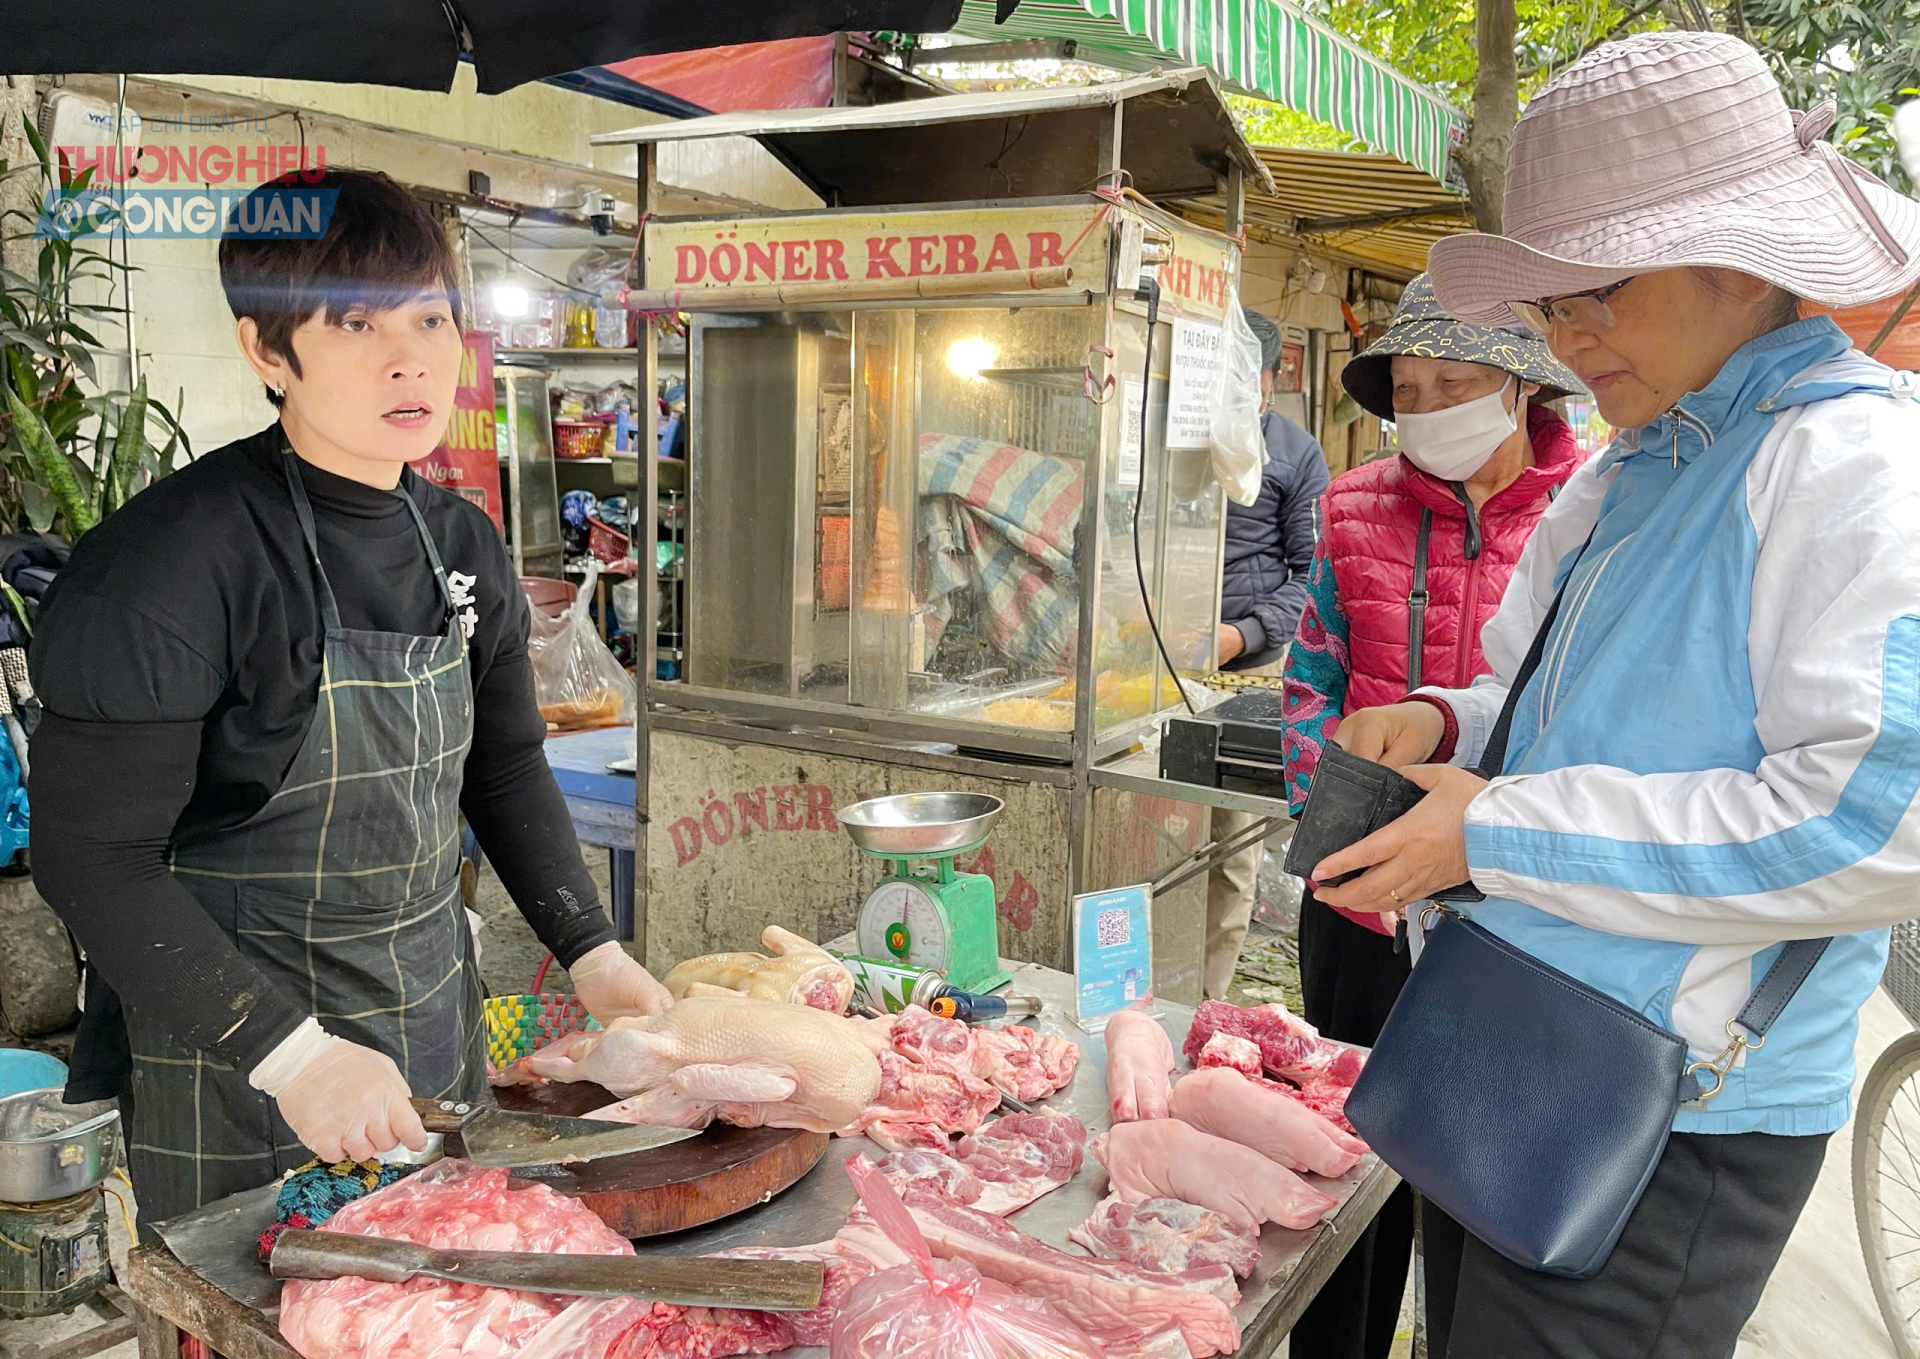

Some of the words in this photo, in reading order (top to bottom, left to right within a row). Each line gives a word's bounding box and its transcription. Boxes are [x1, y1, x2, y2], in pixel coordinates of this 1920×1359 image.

[674, 232, 850, 285] DÖNER
[425, 461, 464, 483] Ngon
[667, 783, 840, 869] DÖNER
